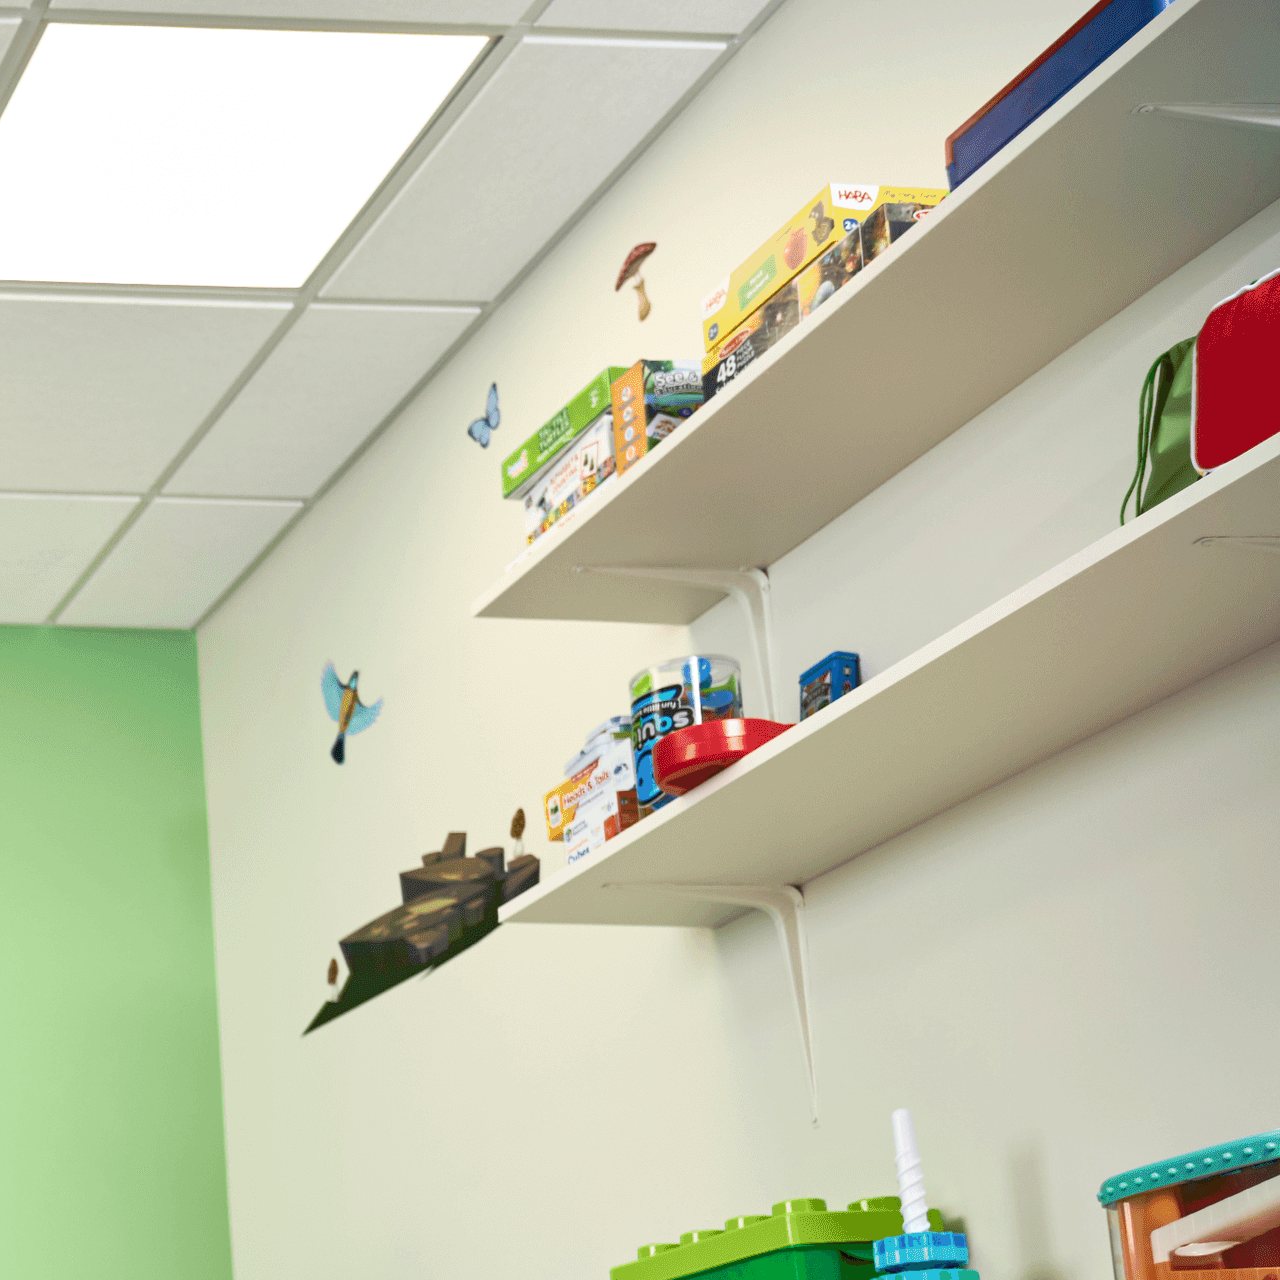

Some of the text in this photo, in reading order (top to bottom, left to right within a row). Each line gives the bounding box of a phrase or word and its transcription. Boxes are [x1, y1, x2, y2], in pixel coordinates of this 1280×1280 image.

[838, 189, 873, 203] HABA
[716, 354, 736, 383] 48
[653, 371, 685, 388] See
[688, 370, 699, 383] &
[661, 699, 677, 709] fun
